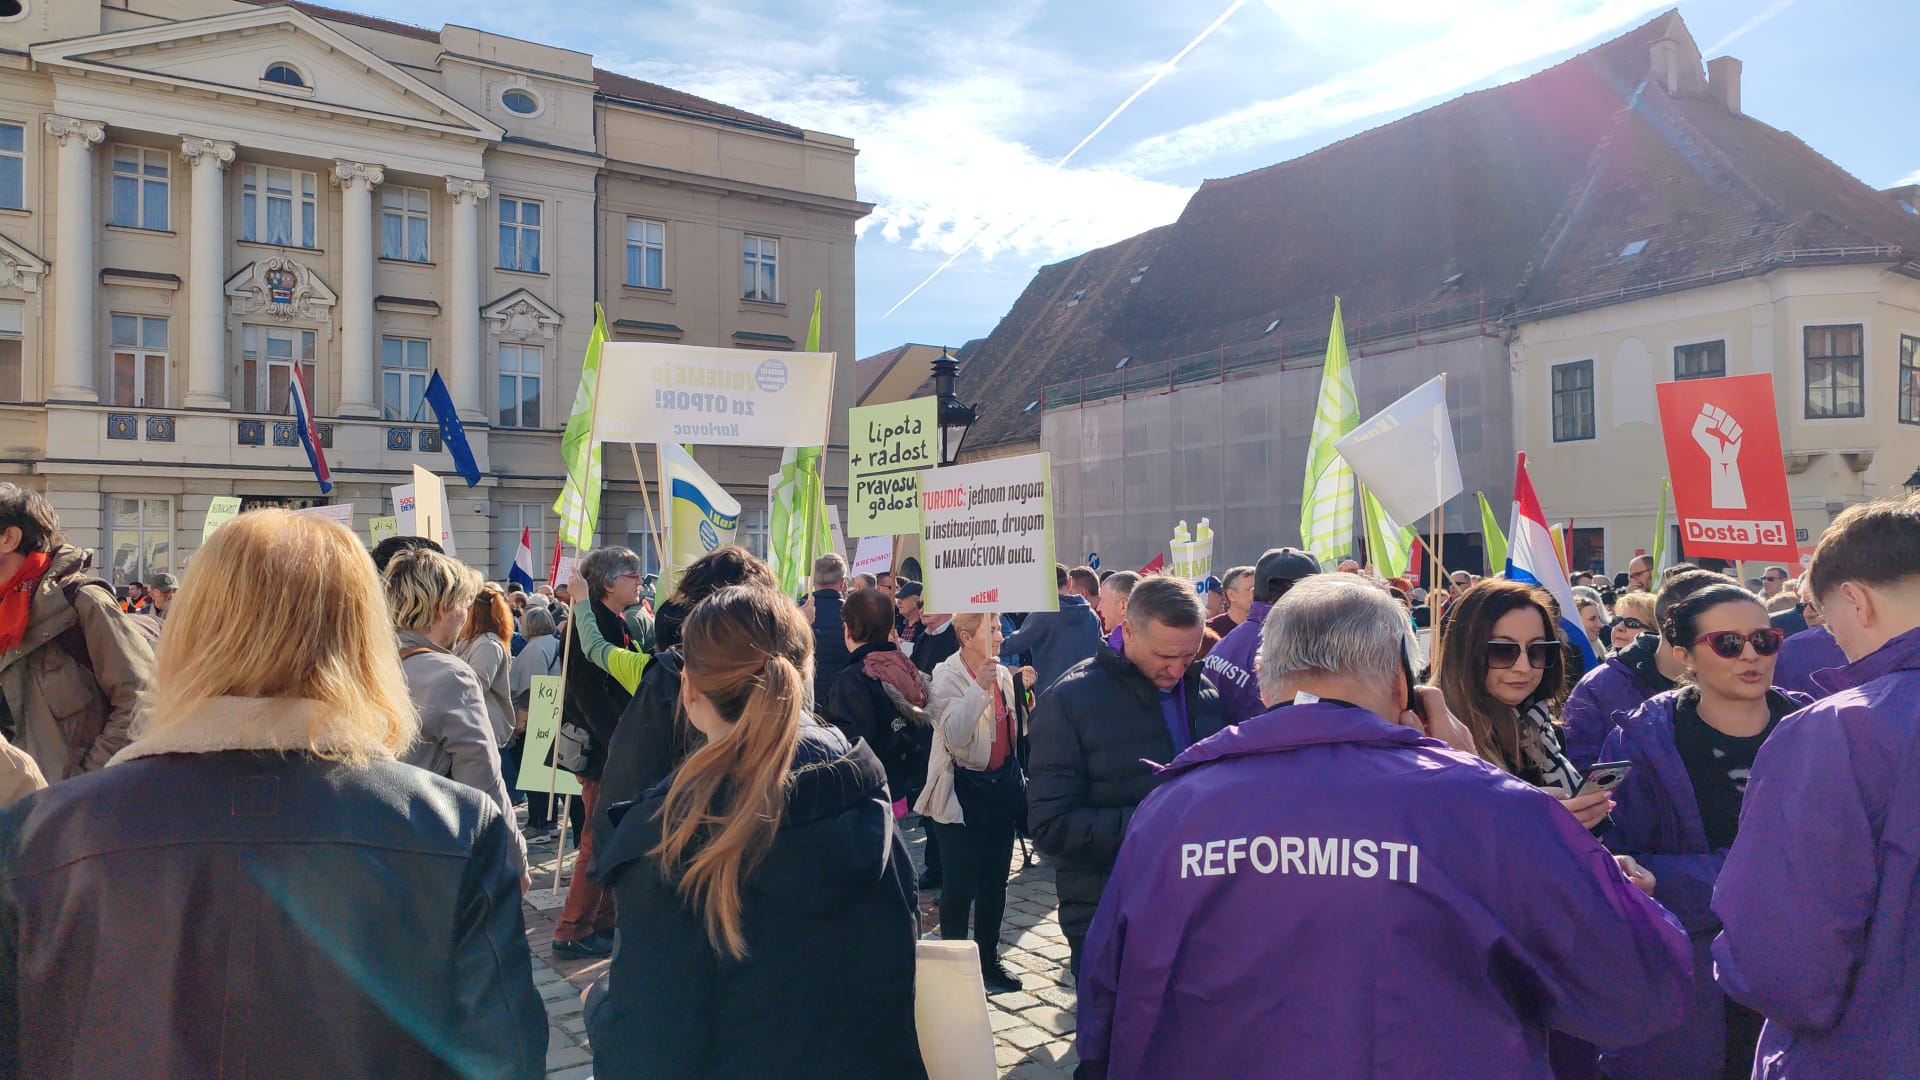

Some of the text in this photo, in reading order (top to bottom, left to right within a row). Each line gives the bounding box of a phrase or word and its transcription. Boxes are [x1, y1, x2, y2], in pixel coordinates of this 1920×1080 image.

[868, 415, 922, 447] lipota
[869, 440, 928, 466] radost
[856, 476, 918, 503] pravosu
[922, 480, 1044, 512] TURUDIĆ: jednom nogom
[925, 513, 1044, 540] u institucijama, drugom
[1687, 522, 1784, 544] Dosta je!
[855, 552, 891, 568] KRENIMO!
[935, 543, 1035, 569] u MAMIĆEVOM autu.
[1180, 835, 1419, 884] REFORMISTI
